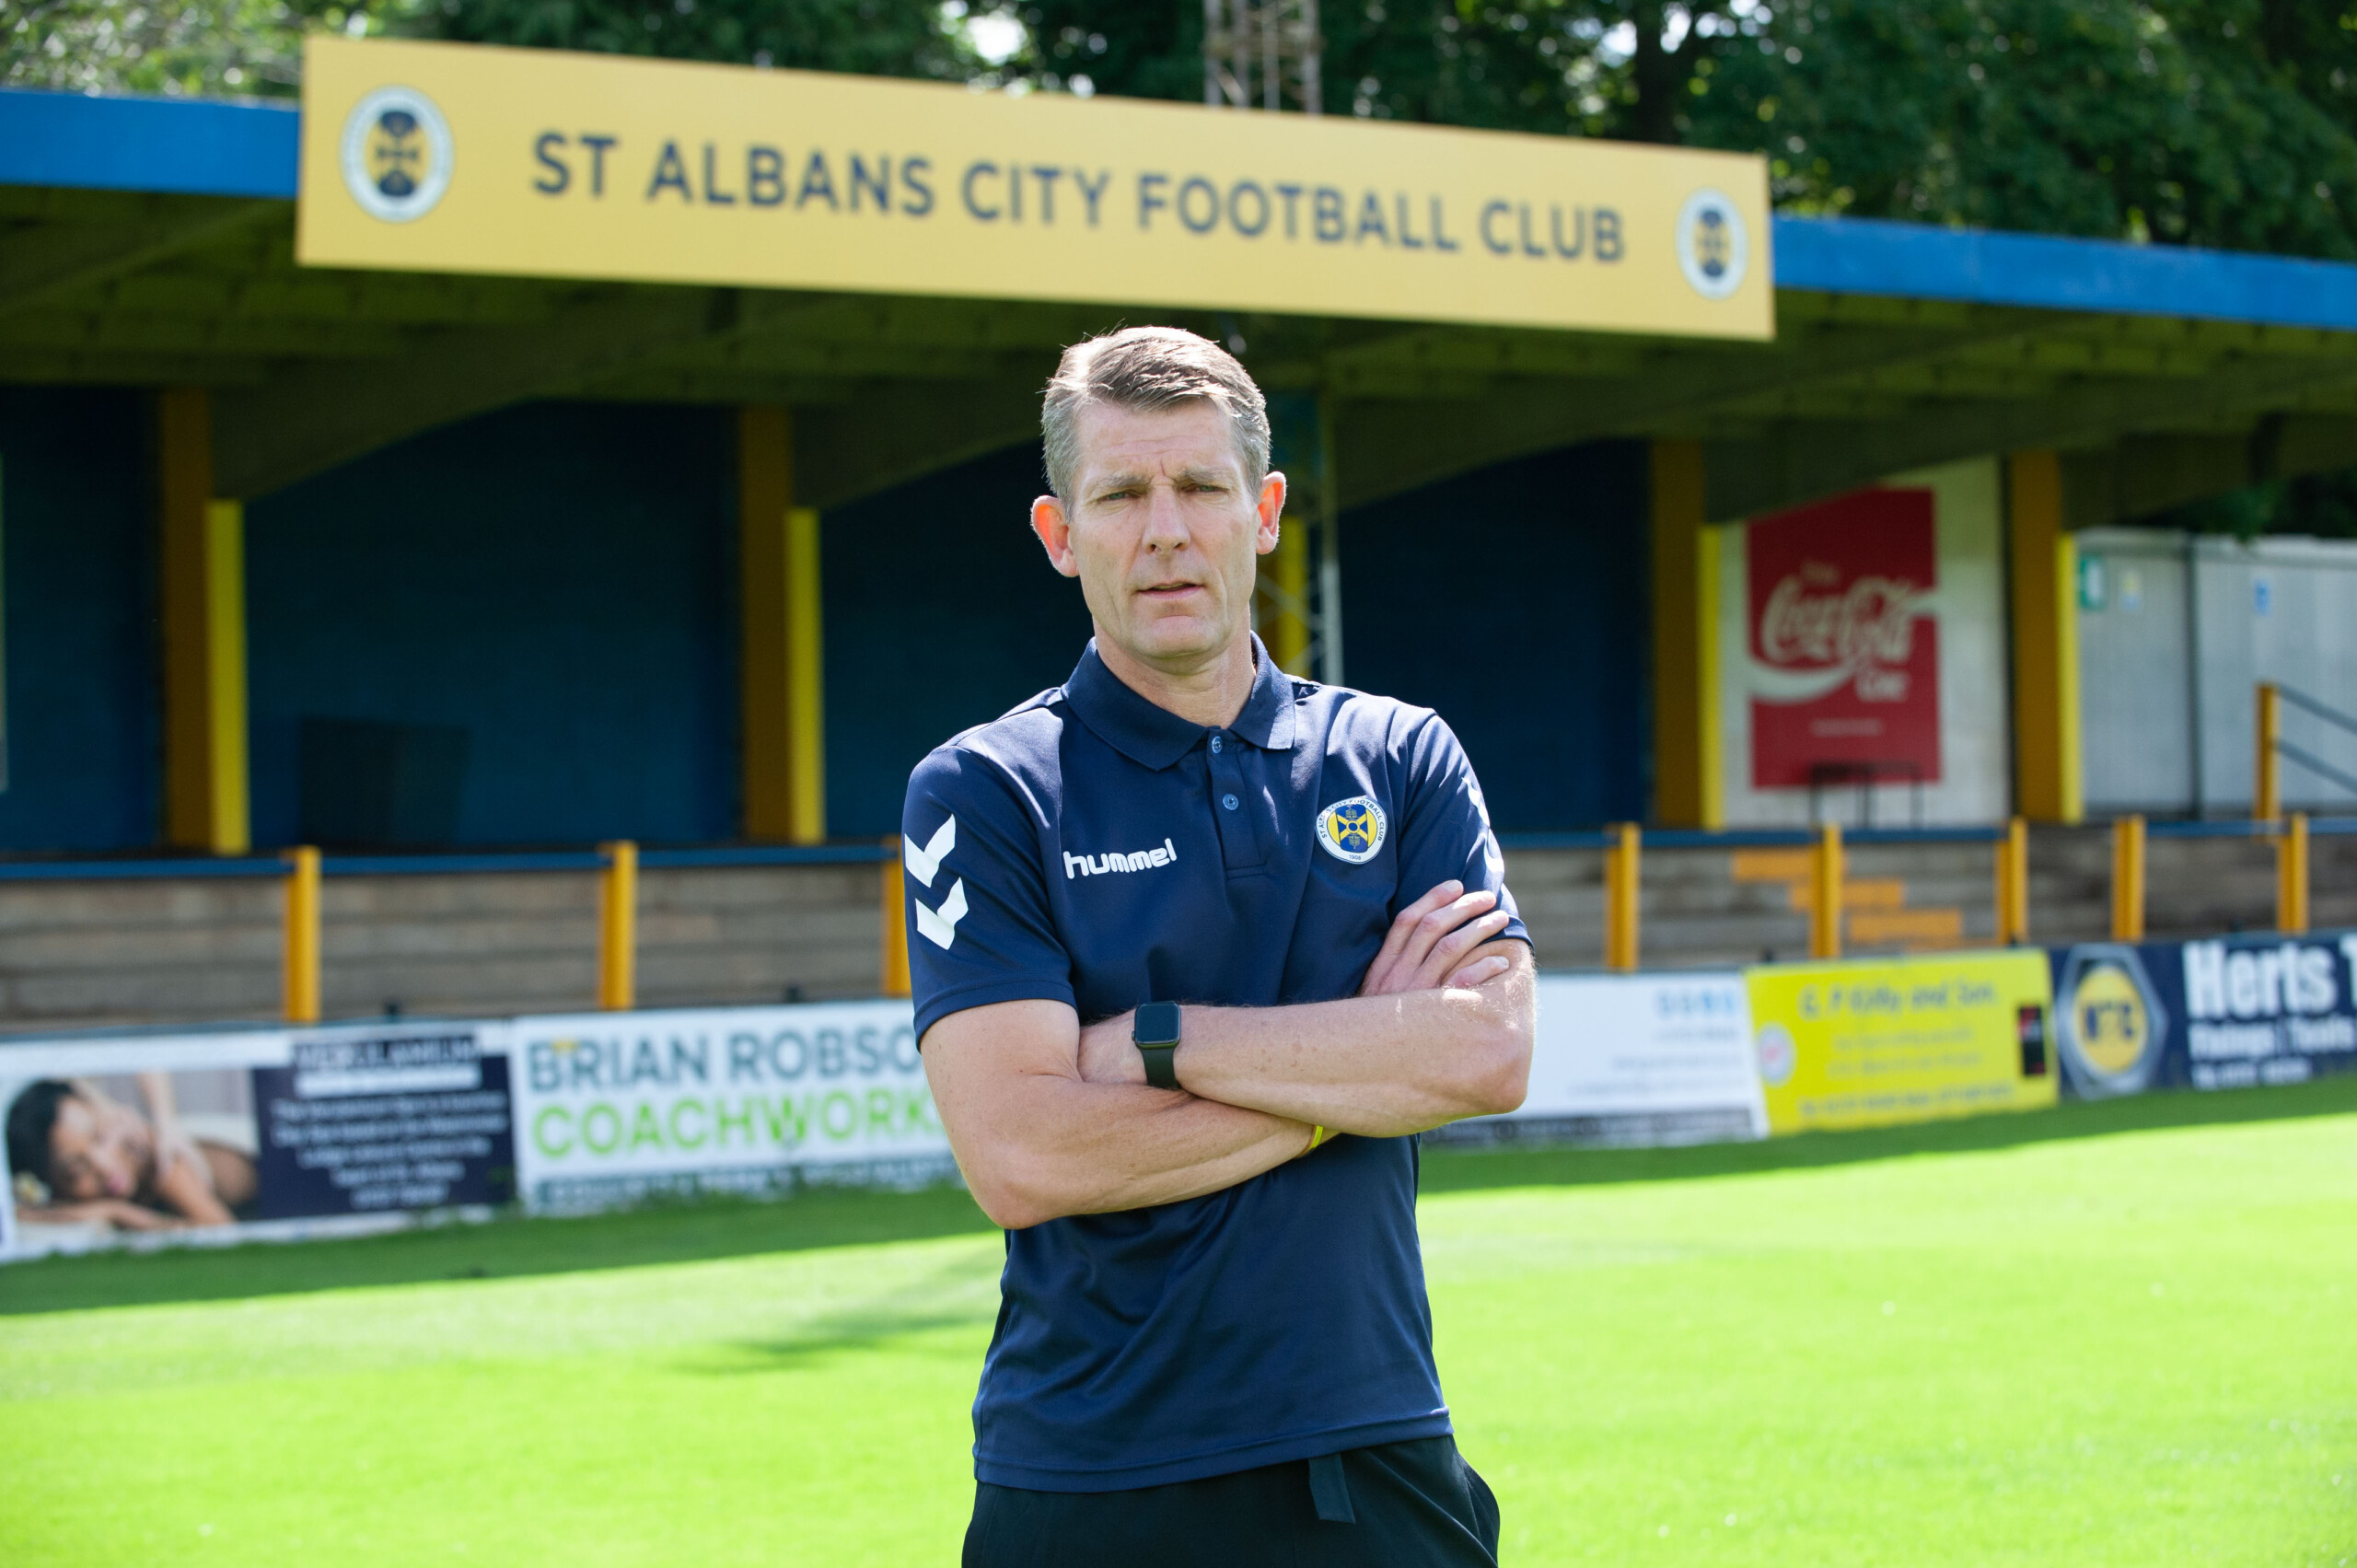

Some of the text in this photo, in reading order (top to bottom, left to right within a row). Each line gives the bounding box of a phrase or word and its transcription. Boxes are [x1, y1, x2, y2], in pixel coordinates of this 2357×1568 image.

[532, 130, 618, 197] ST
[646, 140, 935, 217] ALBANS
[962, 160, 1109, 226] CITY
[1138, 172, 1459, 251] FOOTBALL
[1480, 200, 1625, 263] CLUB
[1063, 838, 1178, 879] hummel
[2183, 940, 2338, 1018] Herts
[528, 1033, 709, 1094] BRIAN
[729, 1023, 923, 1083] ROBSO
[534, 1088, 941, 1160] COACHWORK
